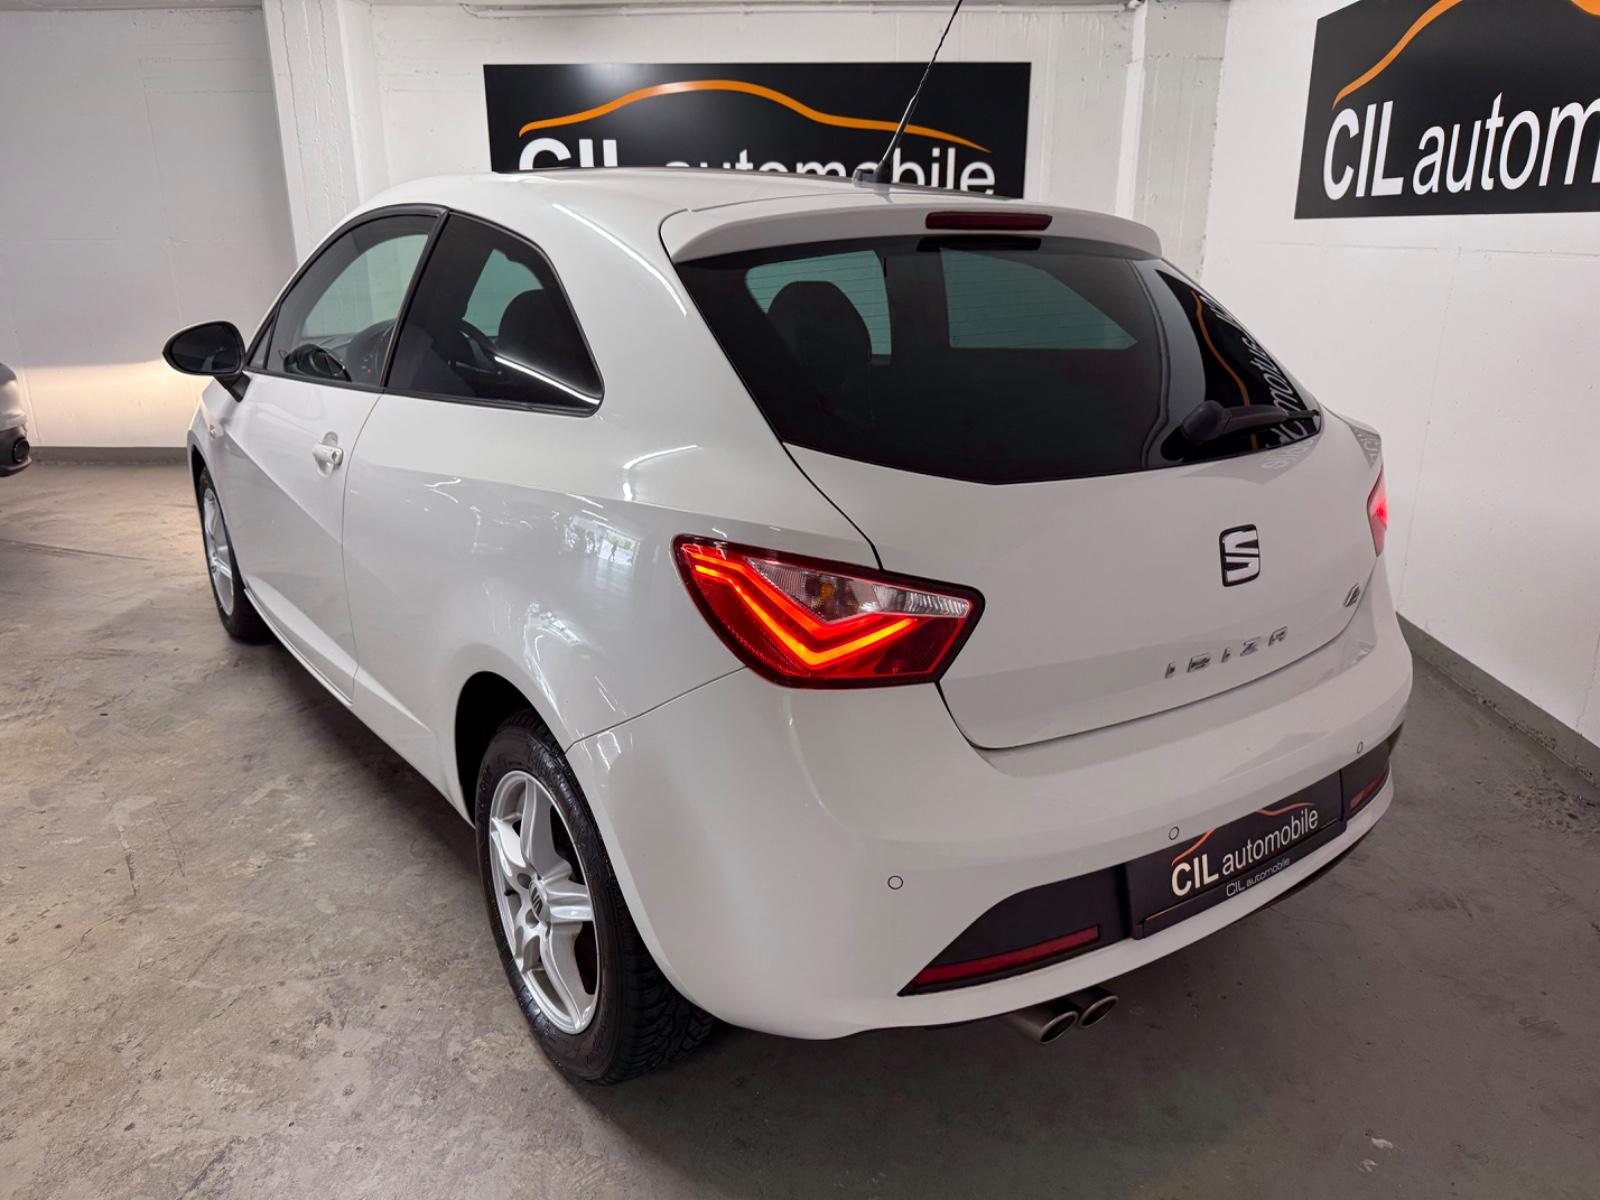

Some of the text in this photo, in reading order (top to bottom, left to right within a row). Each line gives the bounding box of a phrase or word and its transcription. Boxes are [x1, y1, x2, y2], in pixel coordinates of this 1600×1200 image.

[1323, 100, 1404, 200] CIL
[1171, 808, 1319, 897] CIL automobile
[1226, 857, 1291, 897] CIL automobile
